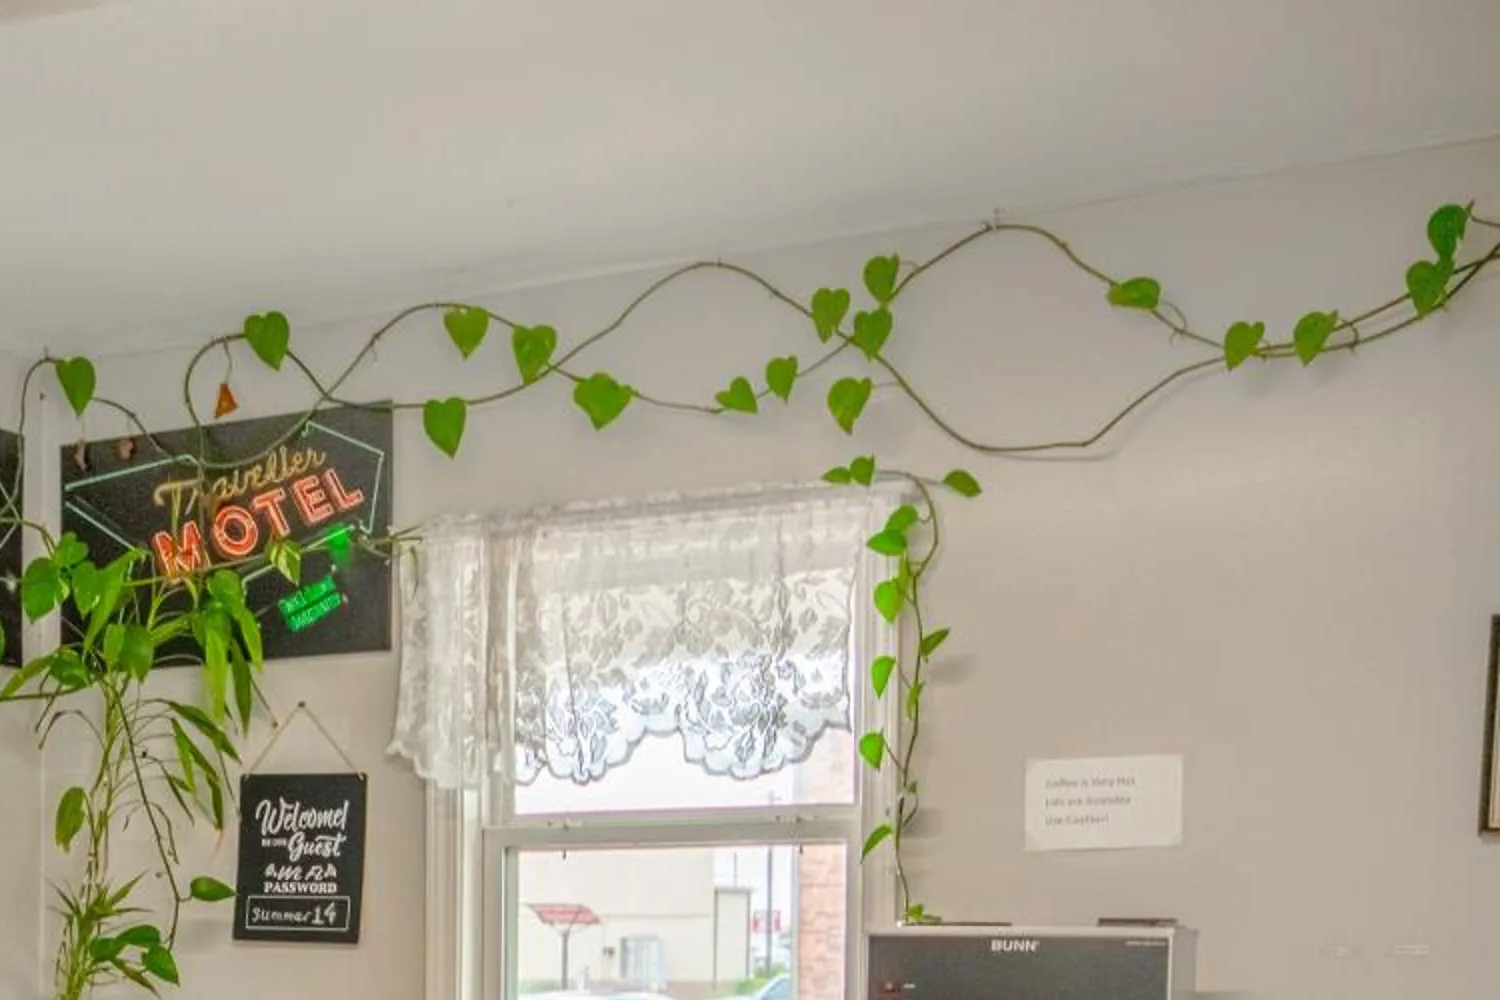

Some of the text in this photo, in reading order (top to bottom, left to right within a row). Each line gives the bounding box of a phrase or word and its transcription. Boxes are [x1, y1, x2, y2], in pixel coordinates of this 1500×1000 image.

[154, 468, 364, 581] MOTEL
[287, 831, 348, 862] Guest
[263, 881, 338, 894] PASSWORD
[991, 939, 1037, 953] BUNN
